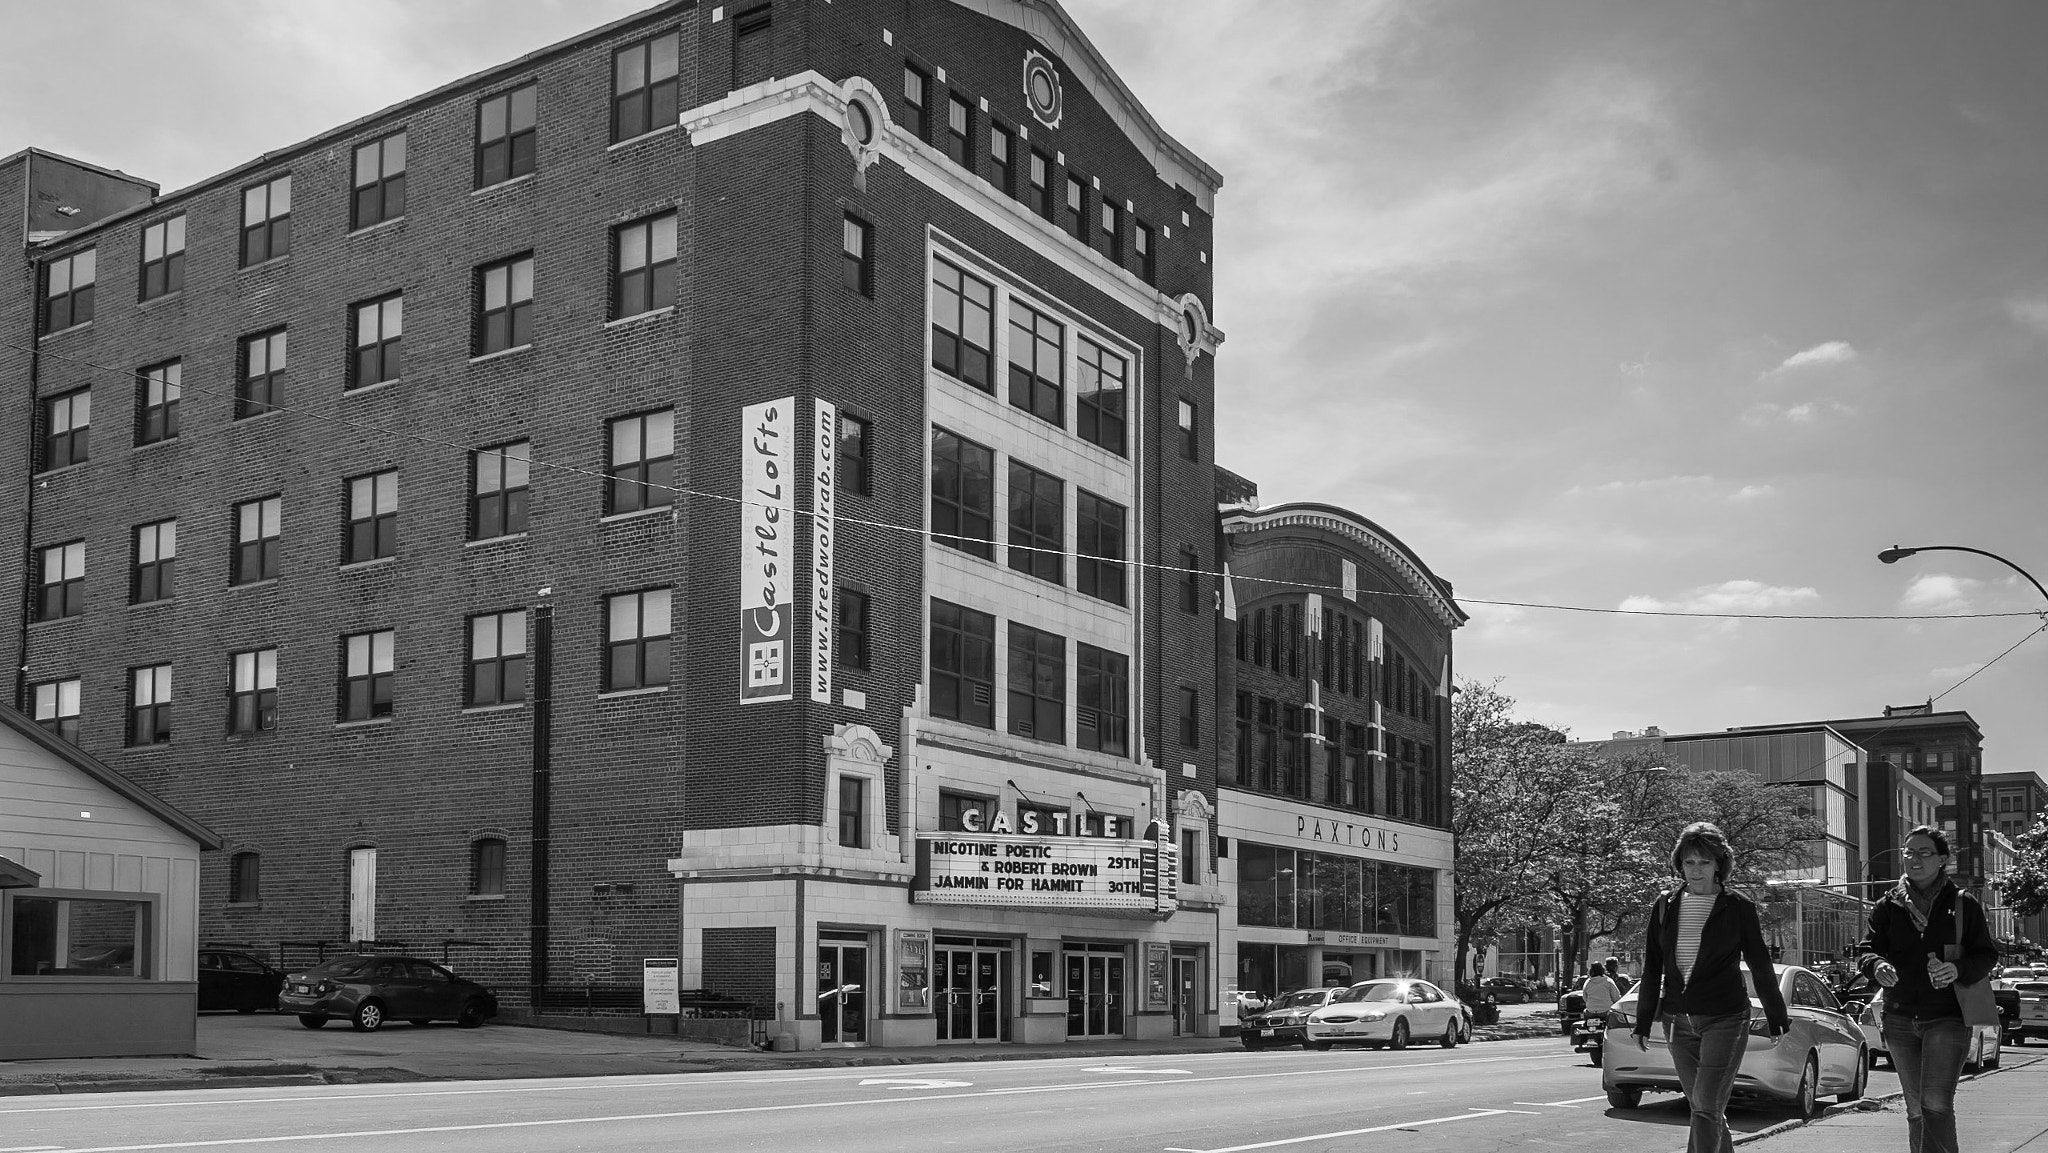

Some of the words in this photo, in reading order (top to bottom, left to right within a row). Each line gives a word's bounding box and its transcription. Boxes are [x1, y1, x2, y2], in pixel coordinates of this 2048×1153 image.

[743, 458, 753, 571] 309-8303808
[815, 411, 831, 693] www.fredwollrab.com
[962, 808, 1117, 838] CASTLE
[1297, 816, 1399, 851] PAXTONS
[934, 842, 998, 857] NICOTINE
[1005, 845, 1051, 858] POETIC
[981, 861, 990, 872] &
[994, 861, 1046, 875] ROBERT
[1051, 863, 1098, 876] BROWN
[1107, 857, 1139, 869] 29TH
[934, 875, 989, 889] JAMMIN
[997, 877, 1024, 890] FOR
[1031, 878, 1084, 892] HAMMIT
[1108, 881, 1140, 893] 30TH
[1338, 934, 1357, 944] OFFICE
[1361, 936, 1389, 945] EQUIPMENT
